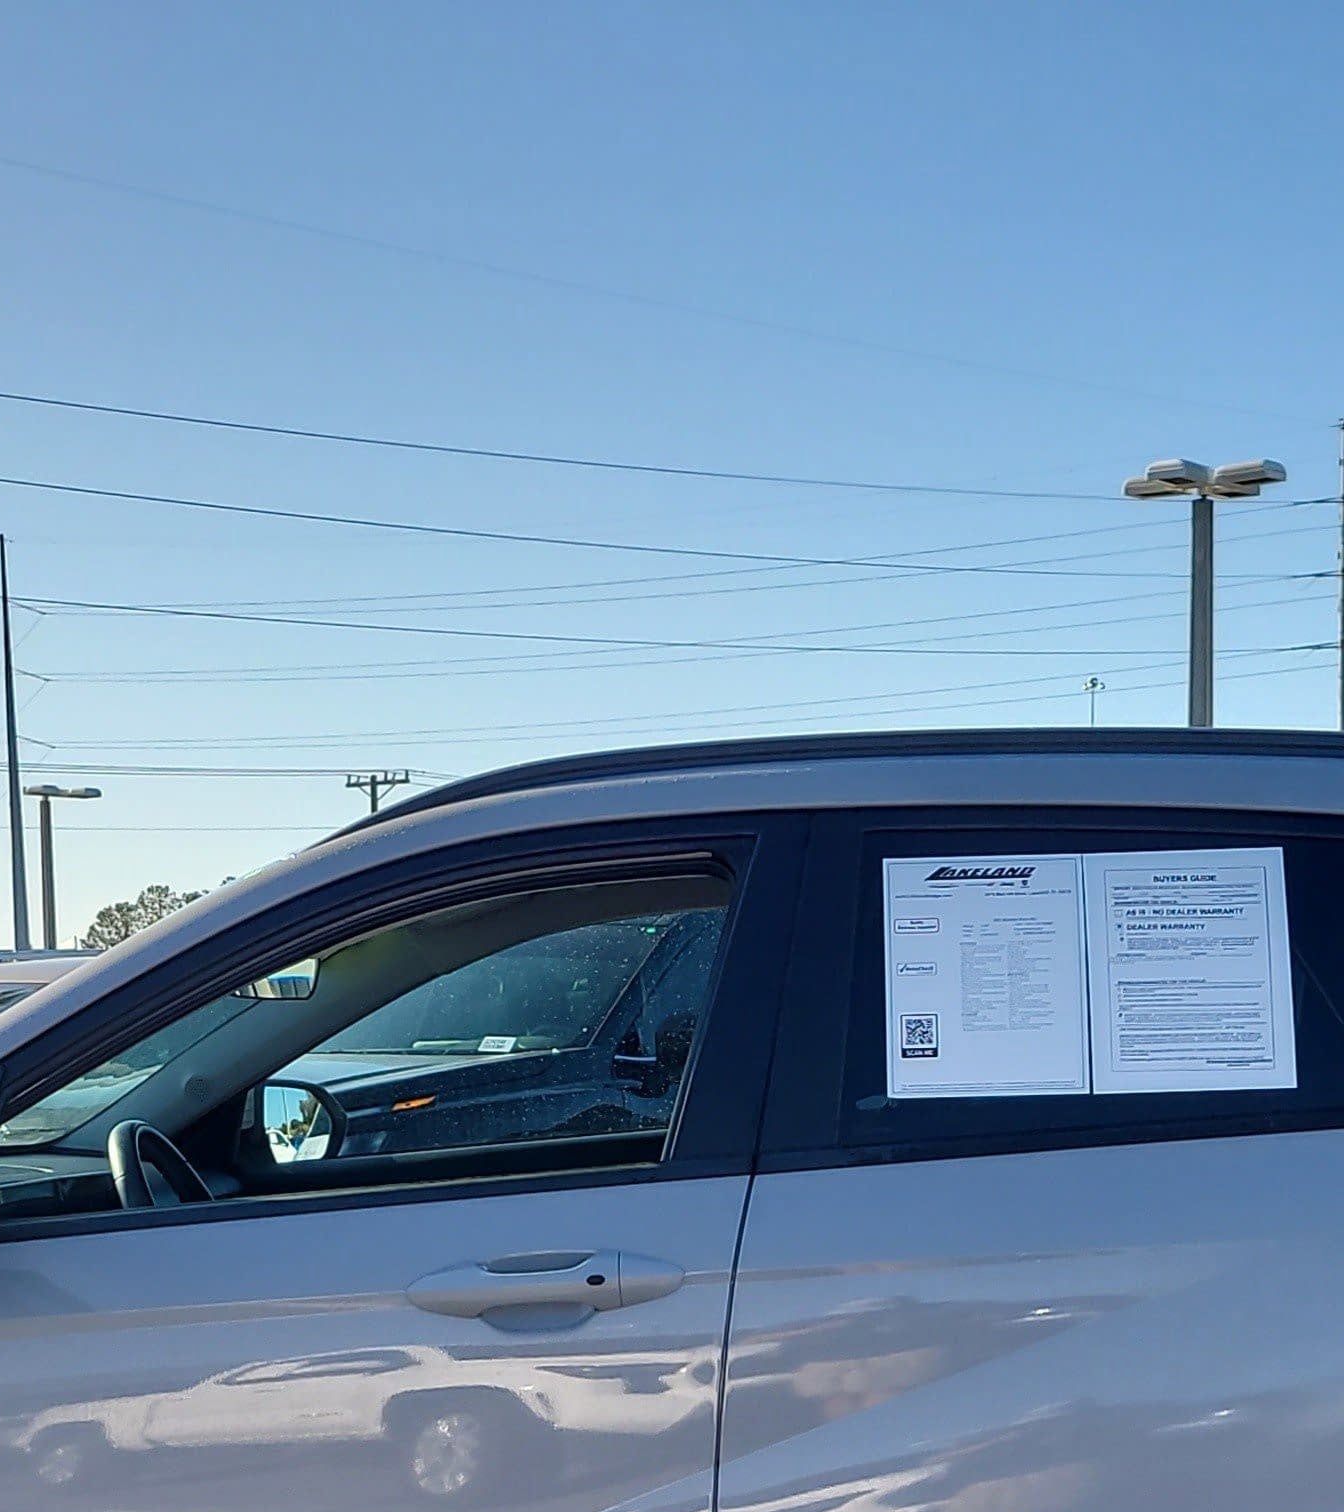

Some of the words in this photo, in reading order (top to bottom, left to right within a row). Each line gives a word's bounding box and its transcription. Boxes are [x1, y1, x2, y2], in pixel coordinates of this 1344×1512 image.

[924, 866, 1036, 881] LAKELAND
[1153, 875, 1188, 883] BUYERS
[1190, 874, 1217, 882] GUIDE
[1166, 908, 1198, 916] DEALER
[1199, 907, 1244, 915] WARRANTY
[1126, 923, 1158, 931] DEALER
[1160, 923, 1205, 931] WARRANTY
